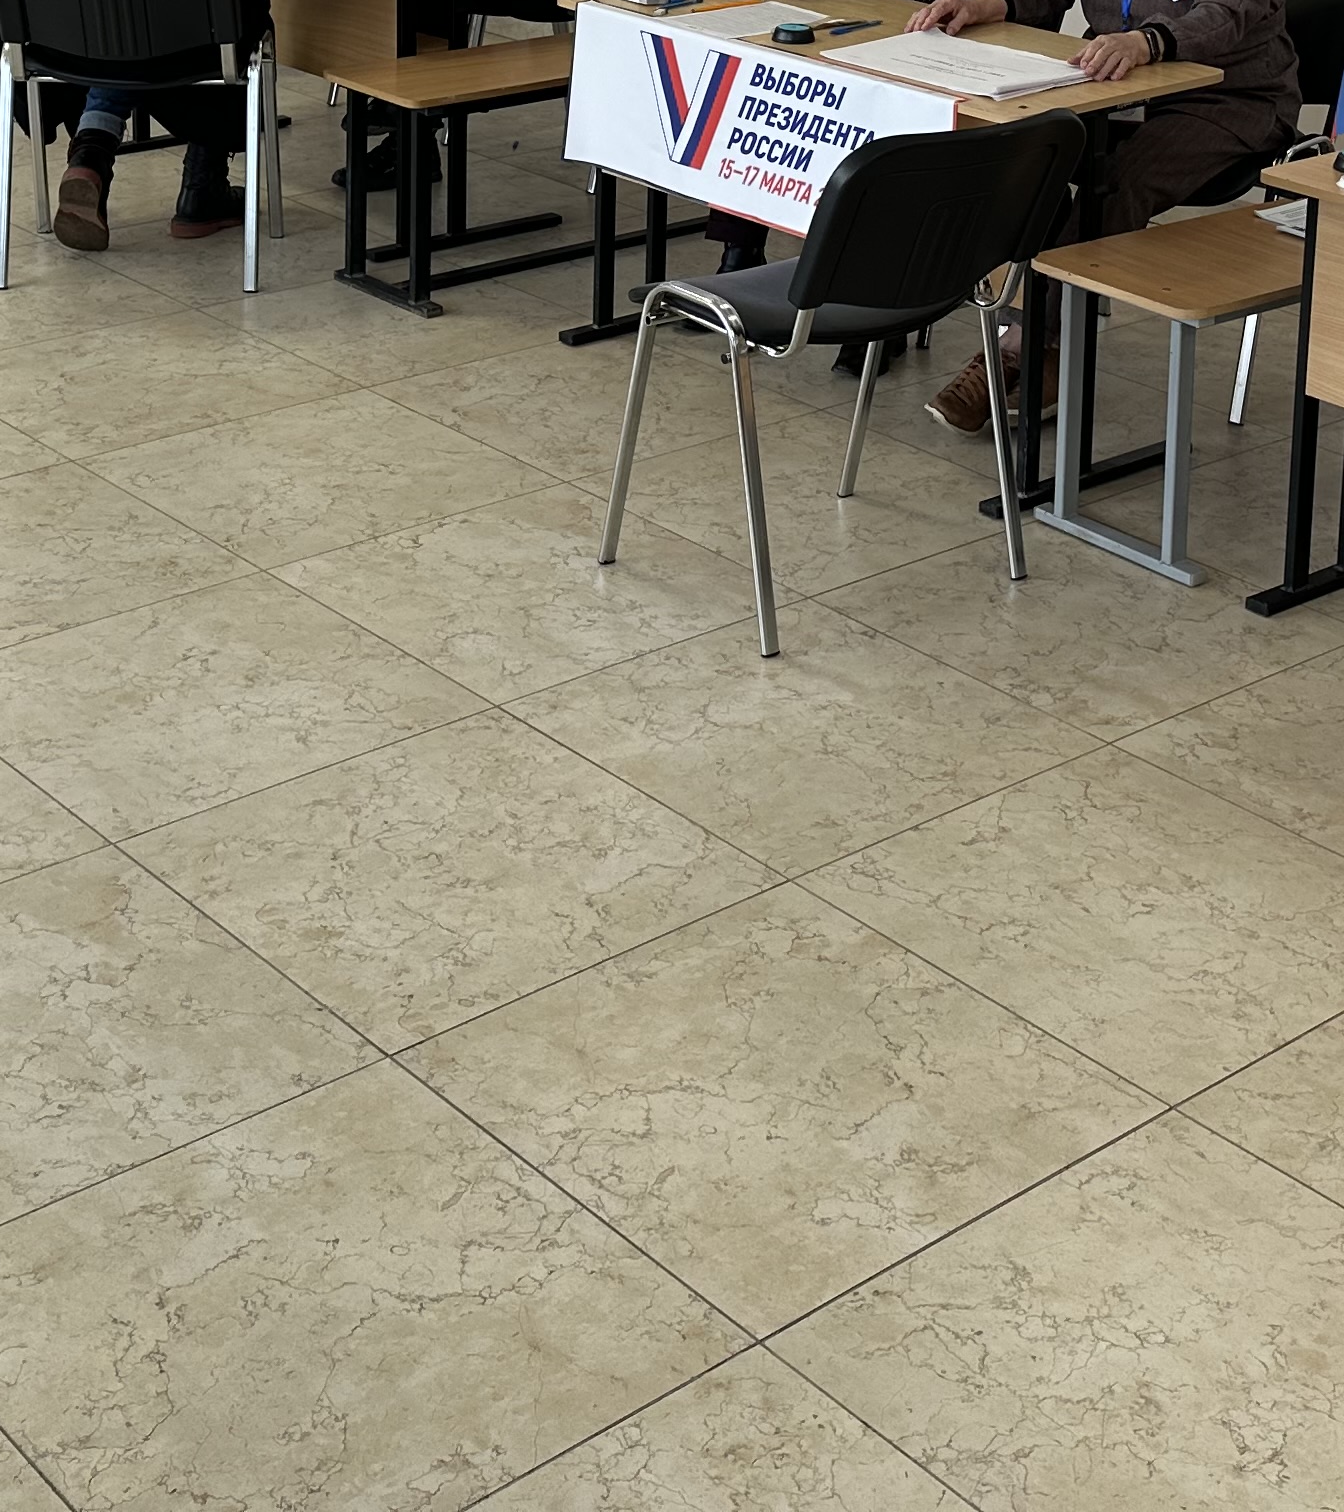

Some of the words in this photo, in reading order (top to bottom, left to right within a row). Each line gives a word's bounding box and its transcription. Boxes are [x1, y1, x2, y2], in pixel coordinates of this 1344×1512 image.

[749, 62, 847, 111] ВЫБОРЫ
[726, 126, 814, 173] РОССИИ
[758, 169, 813, 205] МАРТА
